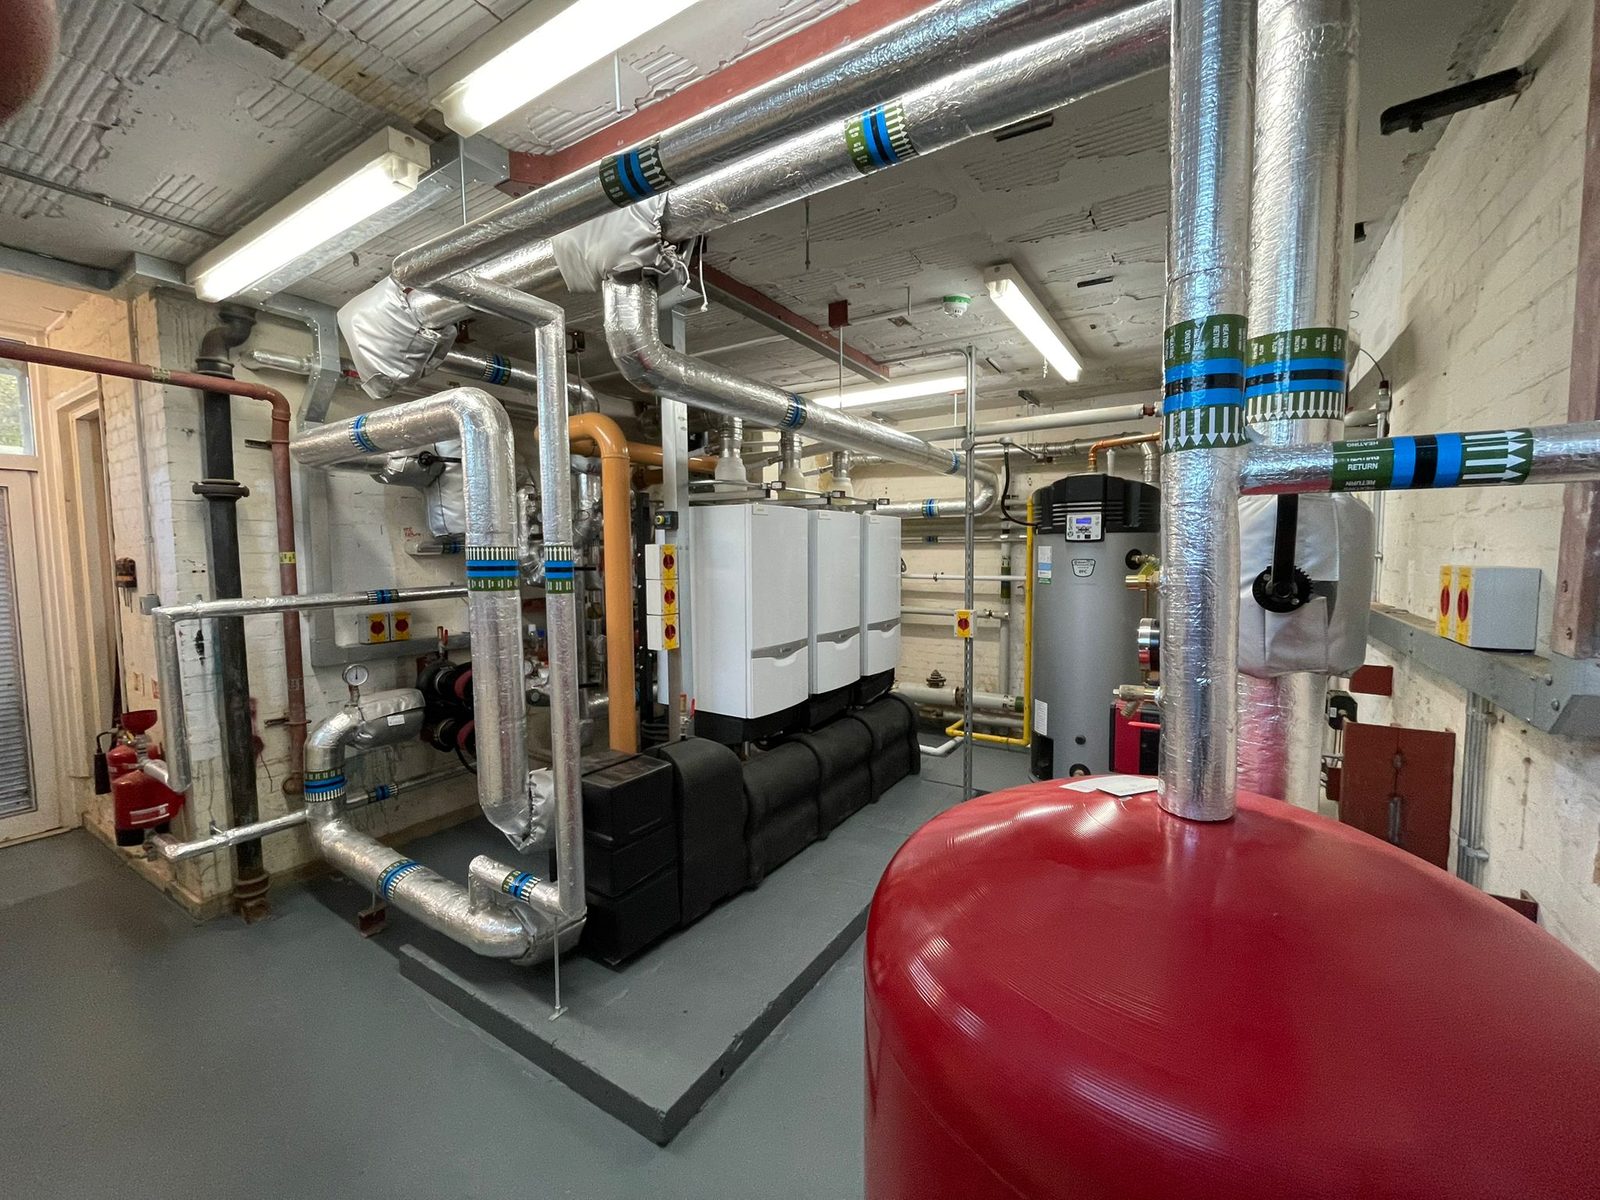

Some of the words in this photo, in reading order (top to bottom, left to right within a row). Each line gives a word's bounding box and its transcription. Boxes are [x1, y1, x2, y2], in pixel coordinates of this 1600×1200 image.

[1212, 325, 1220, 349] RETURN
[1221, 323, 1229, 349] HEATING
[1347, 463, 1379, 471] RETURN
